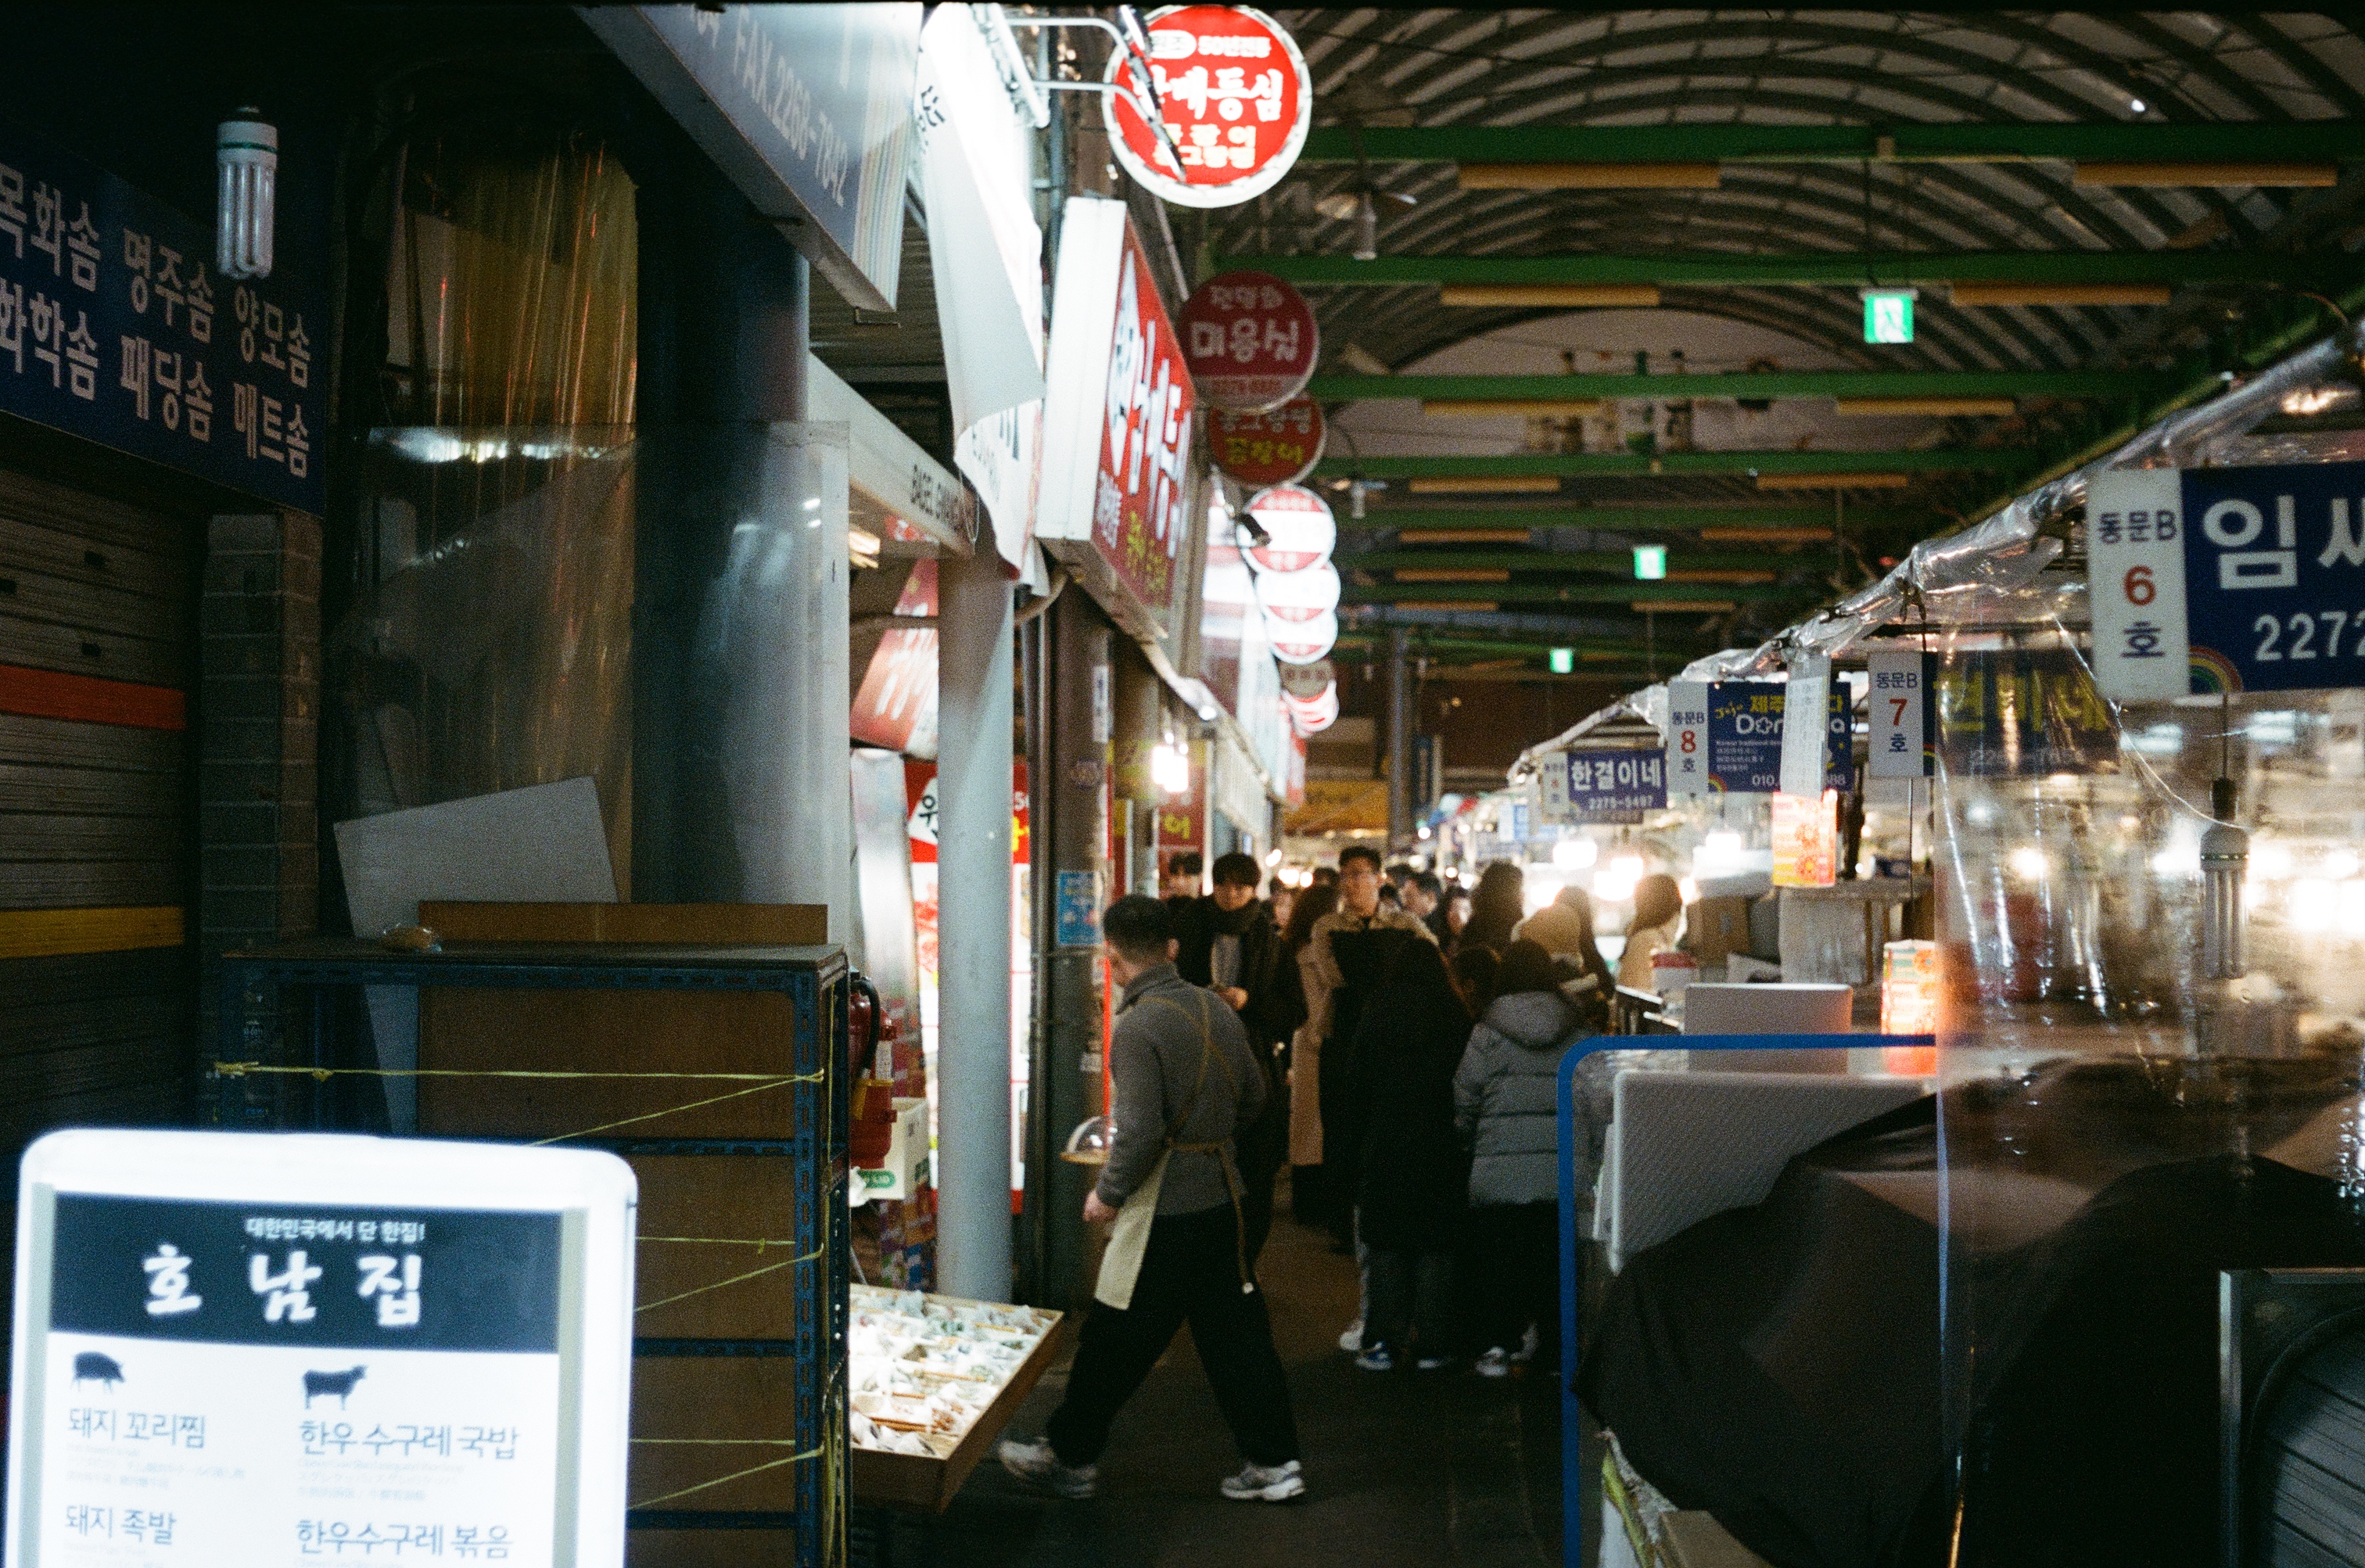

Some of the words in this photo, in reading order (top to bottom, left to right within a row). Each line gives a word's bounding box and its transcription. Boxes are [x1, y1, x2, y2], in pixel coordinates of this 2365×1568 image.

[0, 164, 101, 292] 목화솜
[124, 227, 214, 343] 명주솜
[235, 285, 311, 389] 양모솜
[1190, 317, 1299, 364] 미용실
[121, 335, 213, 443] 패딩솜
[2098, 510, 2177, 544] 동문B
[2123, 565, 2156, 606] 6
[2120, 621, 2165, 658] 호
[1876, 673, 1918, 688] 동문B
[1673, 712, 1705, 725] 동문B
[1889, 698, 1907, 726] 7
[1681, 730, 1696, 753] 8
[1889, 734, 1908, 752] 호
[1571, 758, 1661, 791] 한결이네
[1680, 757, 1696, 772] 호
[245, 1218, 354, 1241] 대한민국에서
[357, 1220, 377, 1242] 단
[67, 1407, 117, 1441] 돼지
[123, 1411, 207, 1449] 꼬리찜
[298, 1419, 358, 1456] 한우
[362, 1422, 453, 1458] 수구레
[457, 1425, 521, 1461] 국밥
[64, 1503, 114, 1539] 돼지
[120, 1508, 178, 1547] 족발
[294, 1518, 444, 1557] 한우수구레
[450, 1524, 515, 1559] 볶음
